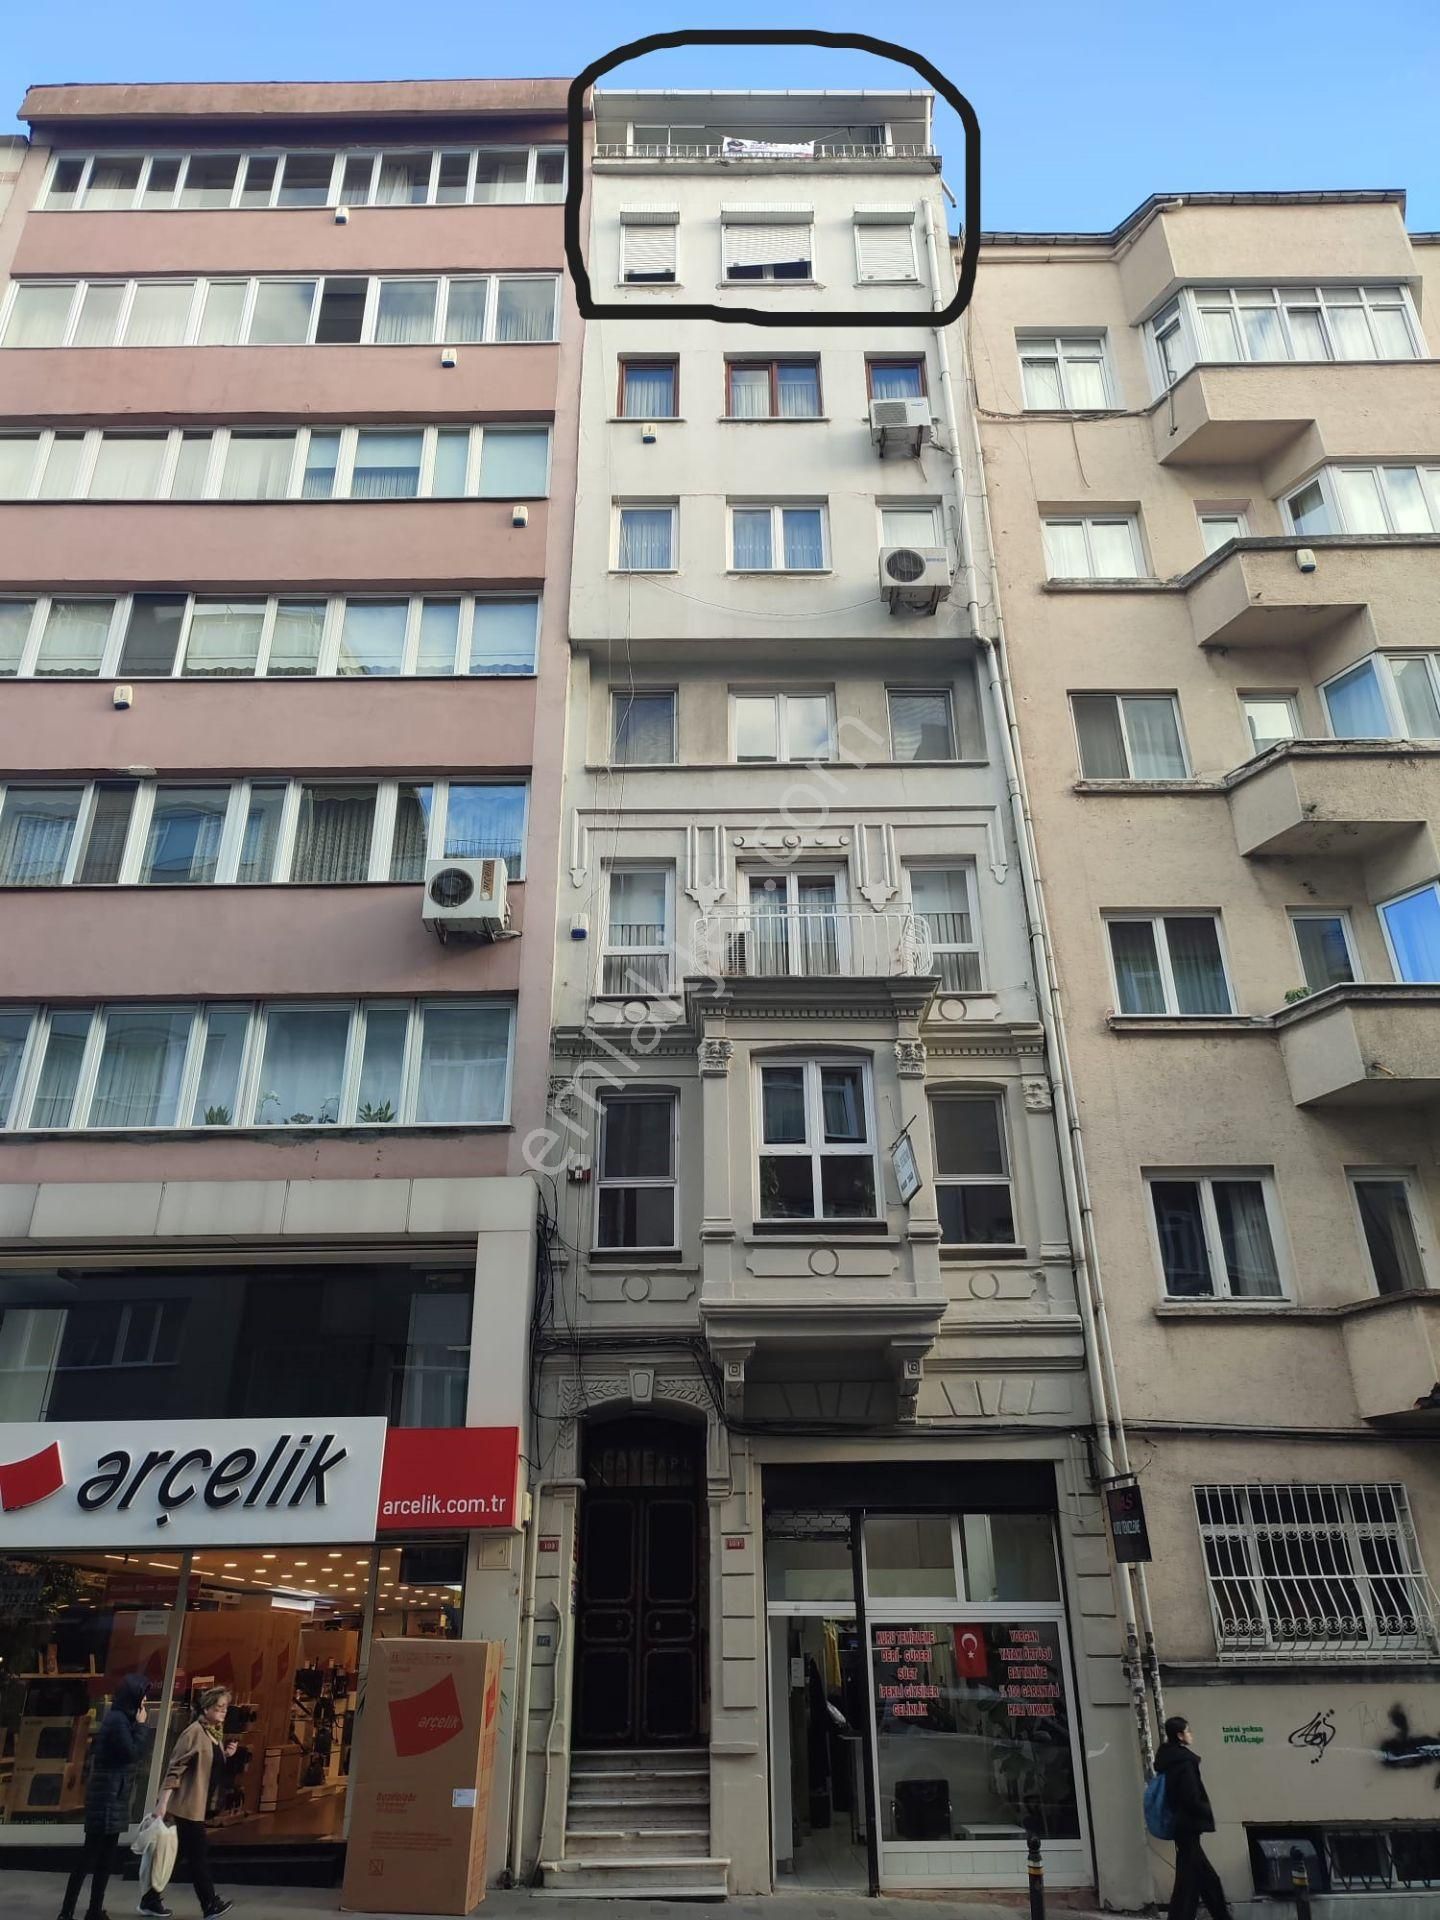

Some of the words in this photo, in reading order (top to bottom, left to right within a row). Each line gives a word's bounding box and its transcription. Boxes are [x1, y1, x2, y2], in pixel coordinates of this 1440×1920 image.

[77, 1434, 348, 1527] arçelik
[383, 1495, 506, 1515] arcelik.com.tr
[876, 1631, 895, 1645] KURU
[895, 1628, 935, 1645] TEMİZLEME
[1009, 1630, 1040, 1643] YORGAN
[903, 1647, 933, 1663] GÜDERİ
[999, 1647, 1023, 1661] YATAK
[1023, 1645, 1053, 1662] ÖRTÜSÜ
[897, 1665, 918, 1680] SÜET
[1008, 1664, 1048, 1680] BATTANİYE
[879, 1683, 904, 1698] İPEKLİ
[904, 1683, 940, 1698] GİYSİLER
[1021, 1682, 1060, 1698] GARANTİLİ
[893, 1701, 928, 1716] GELİNLİK
[1008, 1704, 1026, 1717] HALI
[1026, 1704, 1056, 1717] YIKAMA
[418, 1713, 461, 1730] arçelik
